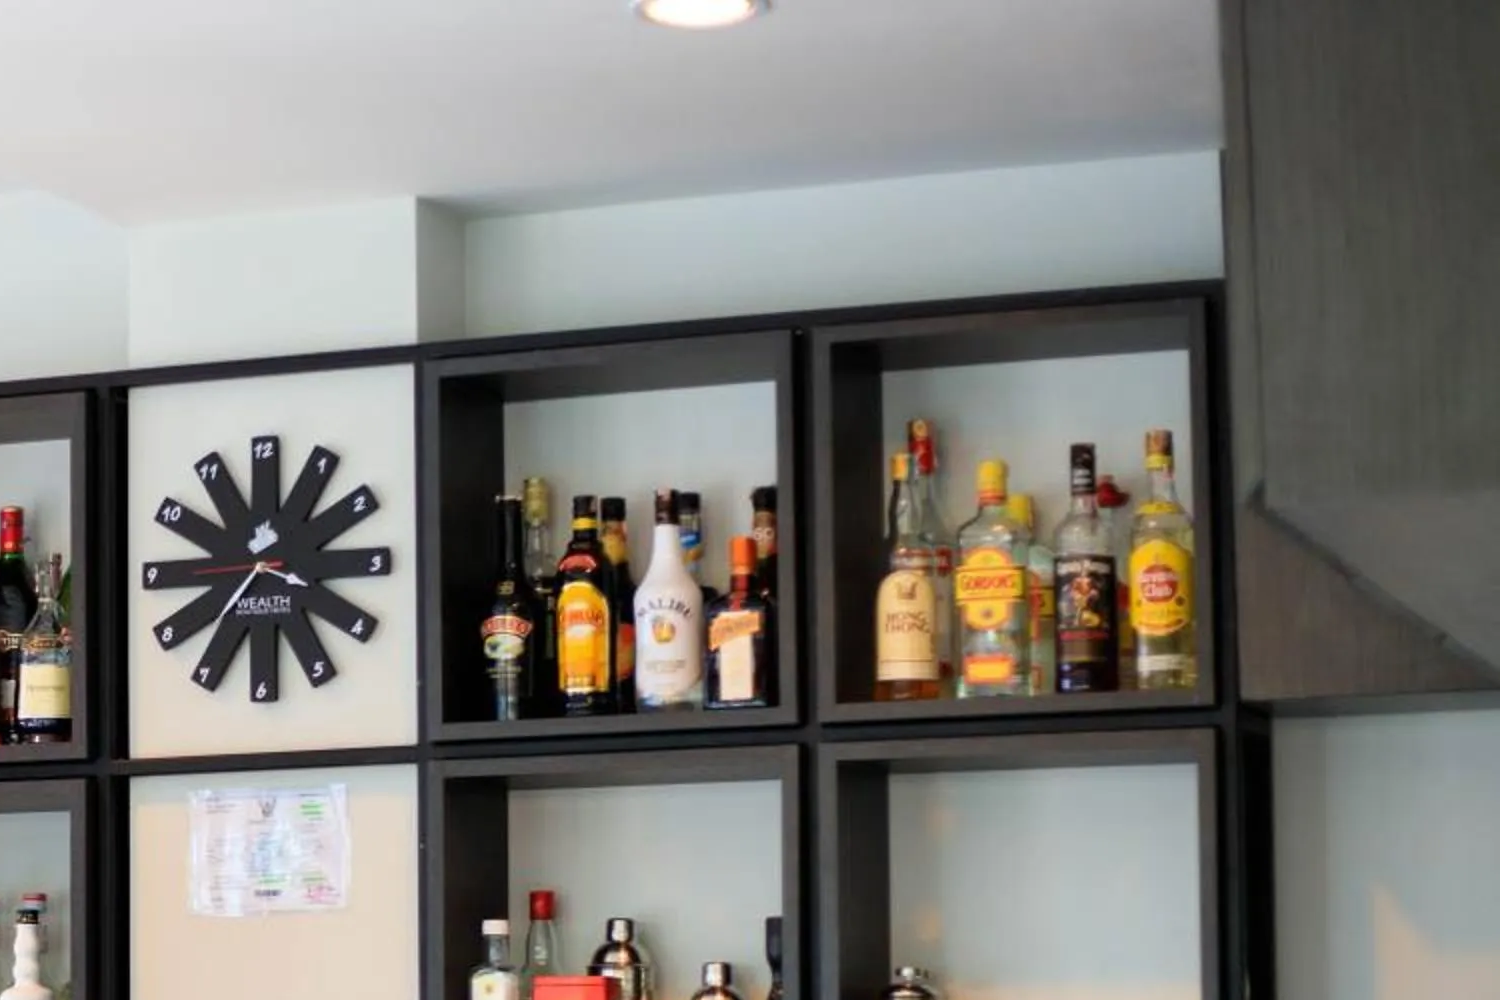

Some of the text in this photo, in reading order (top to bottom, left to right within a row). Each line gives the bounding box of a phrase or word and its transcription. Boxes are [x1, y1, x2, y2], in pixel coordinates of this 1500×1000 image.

[253, 441, 275, 460] 12
[199, 463, 219, 481] 11
[317, 456, 328, 475] 1
[353, 496, 369, 512] 2
[162, 506, 181, 522] 10
[369, 554, 382, 572] 3
[147, 567, 158, 584] 9
[237, 595, 291, 609] WEALTH
[161, 626, 173, 642] 8
[350, 618, 363, 635] 4
[199, 667, 211, 683] 7
[312, 660, 325, 678] 5
[255, 682, 268, 699] 6
